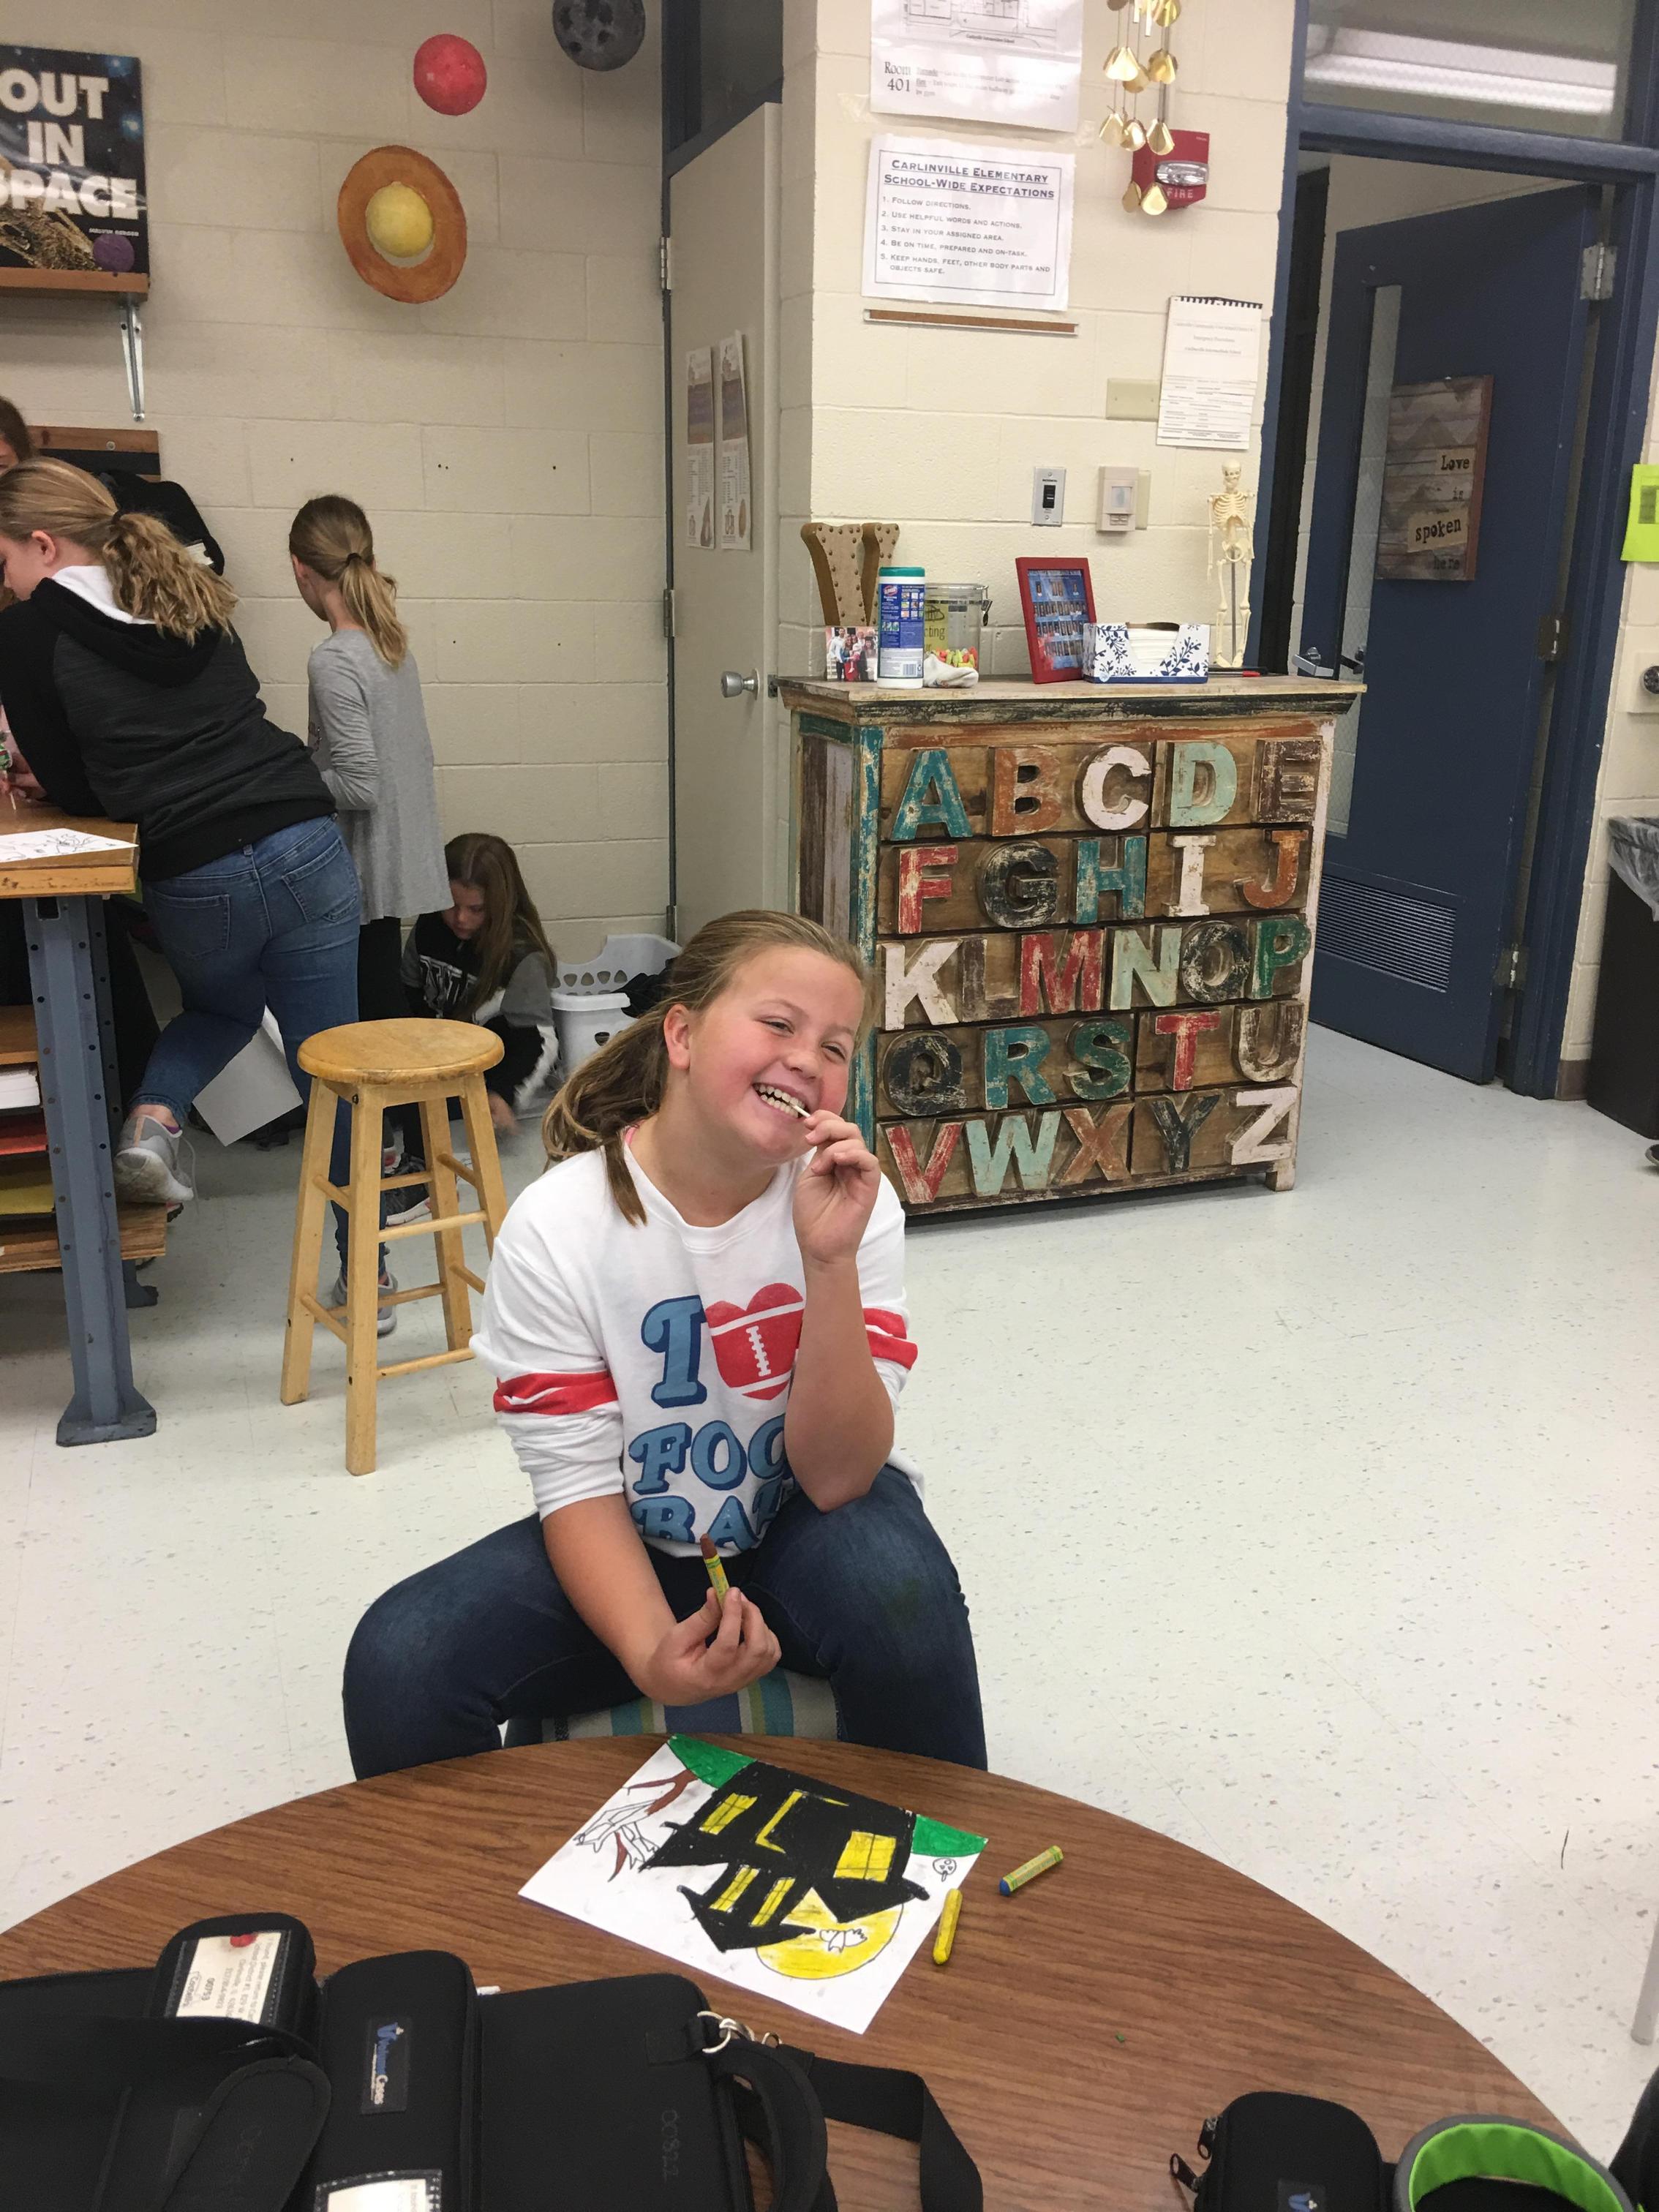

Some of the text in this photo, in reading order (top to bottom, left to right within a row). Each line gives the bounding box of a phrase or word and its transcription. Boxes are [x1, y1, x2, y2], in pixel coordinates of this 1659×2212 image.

[0, 68, 109, 119] OUT
[887, 78, 910, 92] 401
[27, 121, 85, 168] IN
[892, 159, 1048, 183] CARLINVILLE ELEMENTARY
[0, 169, 138, 219] PACE
[884, 174, 1055, 198] SCHOOL-WIDE EXPECTATIONS
[1167, 187, 1194, 199] FIRE
[892, 197, 923, 206] FOLLOW
[909, 213, 944, 222] HELPFUL
[891, 225, 910, 233] STAY
[946, 231, 981, 239] ASSIGNED
[940, 244, 976, 253] PREPARED
[889, 265, 922, 273] OBJECTS
[1441, 455, 1470, 470] Love
[1415, 518, 1462, 543] spoken
[891, 737, 1322, 841] A B C D E
[898, 831, 1308, 933] F G H I J
[884, 916, 1312, 1030] K L M N O P
[887, 1002, 1305, 1116] Q R S T U
[885, 1086, 1298, 1204] V W X Y Z
[642, 1295, 707, 1409] I
[628, 1413, 790, 1495] FOO
